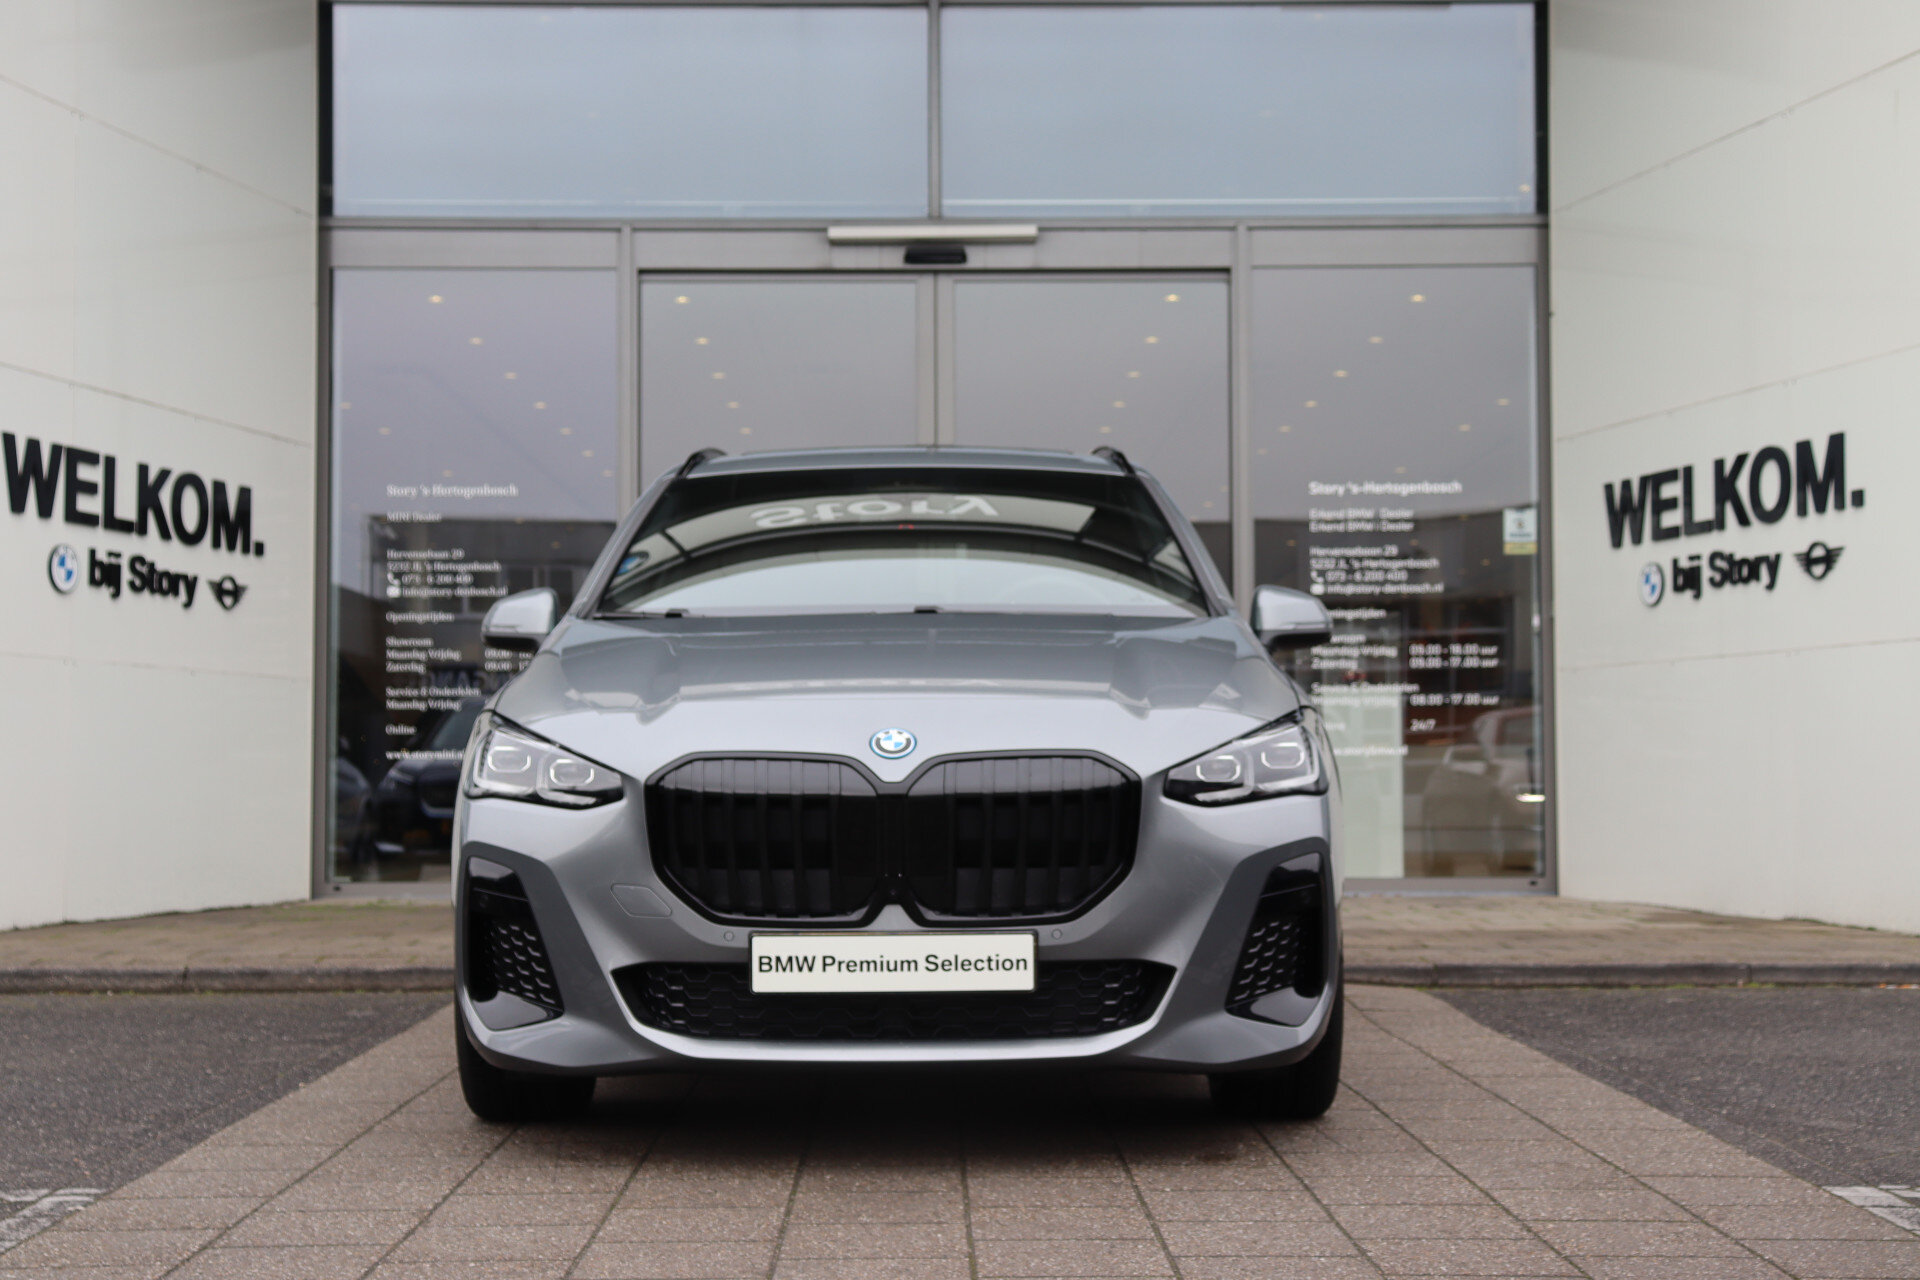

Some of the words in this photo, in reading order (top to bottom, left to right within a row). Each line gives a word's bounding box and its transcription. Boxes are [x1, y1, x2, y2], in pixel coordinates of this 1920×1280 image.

[2, 431, 264, 556] WELKOM.
[386, 484, 417, 499] Story
[1308, 481, 1345, 497] Story
[1604, 432, 1864, 549] WELKOM.
[88, 548, 122, 600] bij
[129, 554, 198, 609] Story
[1672, 555, 1702, 600] bij
[1708, 551, 1781, 591] Story
[1327, 607, 1387, 621] ningstijden
[757, 955, 816, 974] BMW
[821, 954, 919, 973] Premium
[924, 953, 1029, 972] Selection
